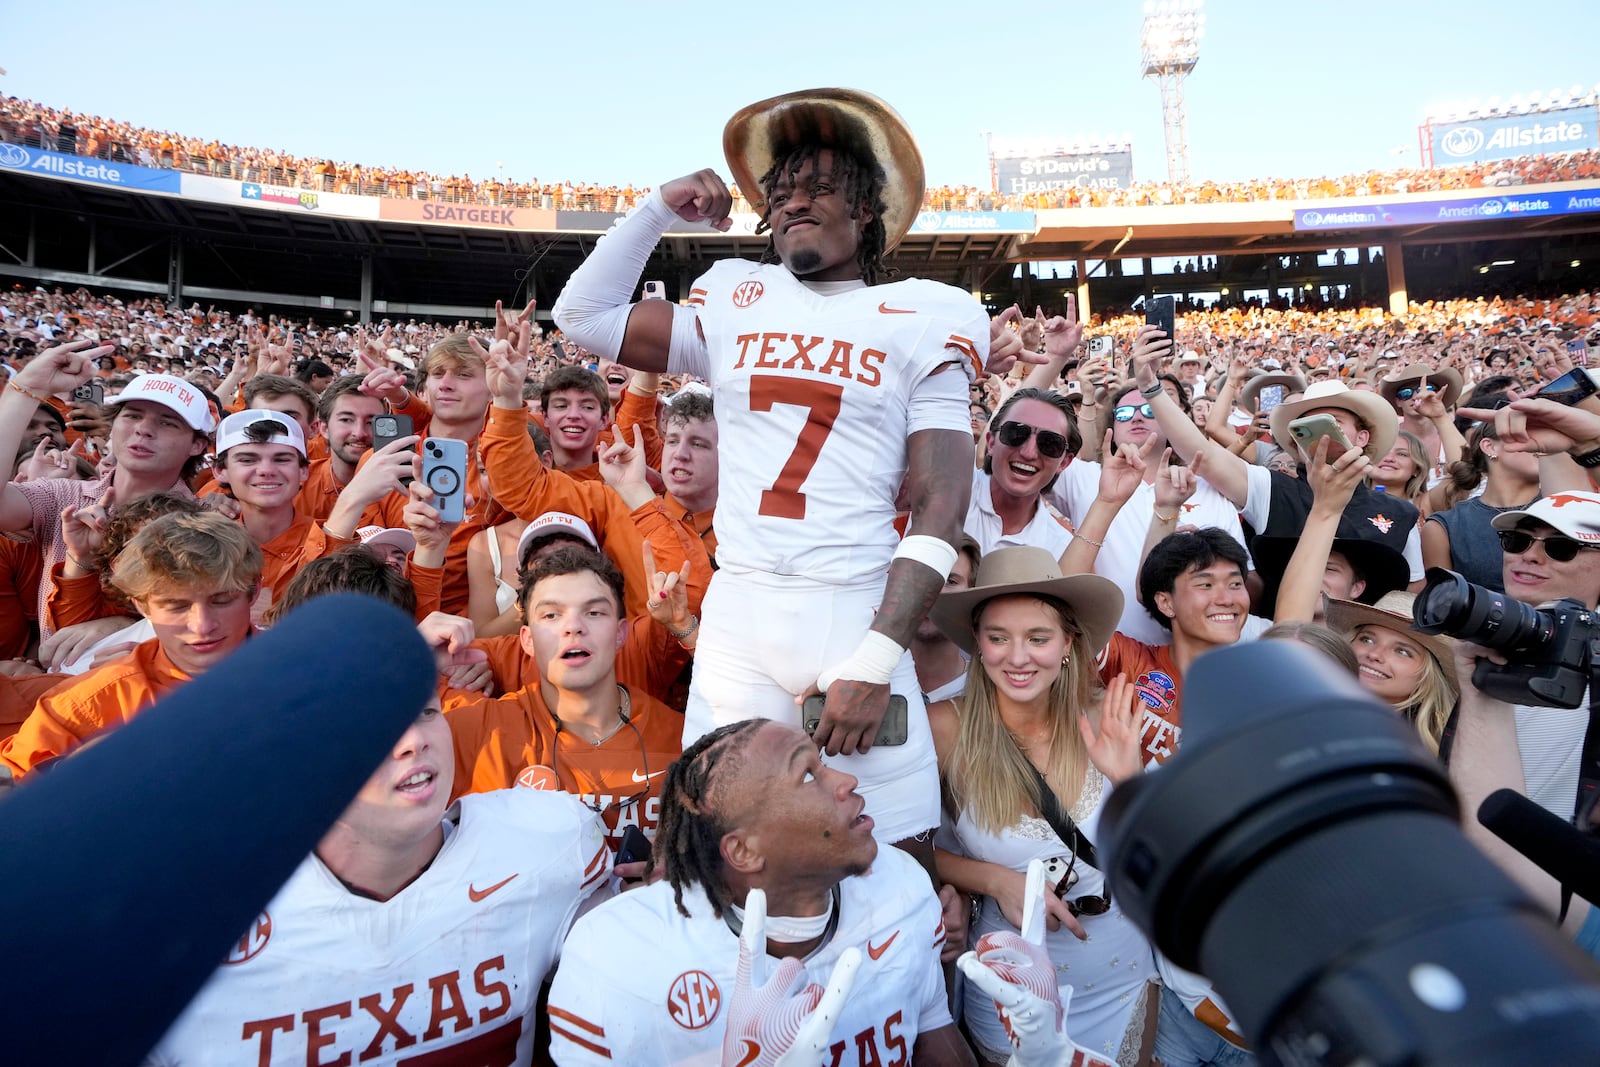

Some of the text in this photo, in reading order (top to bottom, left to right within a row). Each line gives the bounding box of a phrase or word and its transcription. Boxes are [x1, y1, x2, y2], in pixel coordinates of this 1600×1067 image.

[1486, 120, 1582, 149] Allstate
[32, 155, 121, 182] Allstate
[300, 193, 318, 204] 811
[1503, 200, 1549, 213] Allstate
[942, 214, 998, 230] Allstate
[734, 281, 763, 307] SEC
[734, 333, 887, 387] TEXAS
[142, 379, 177, 393] HOOK
[749, 375, 844, 520] 7
[241, 955, 512, 1067] TEXAS
[669, 969, 721, 1030] SEC
